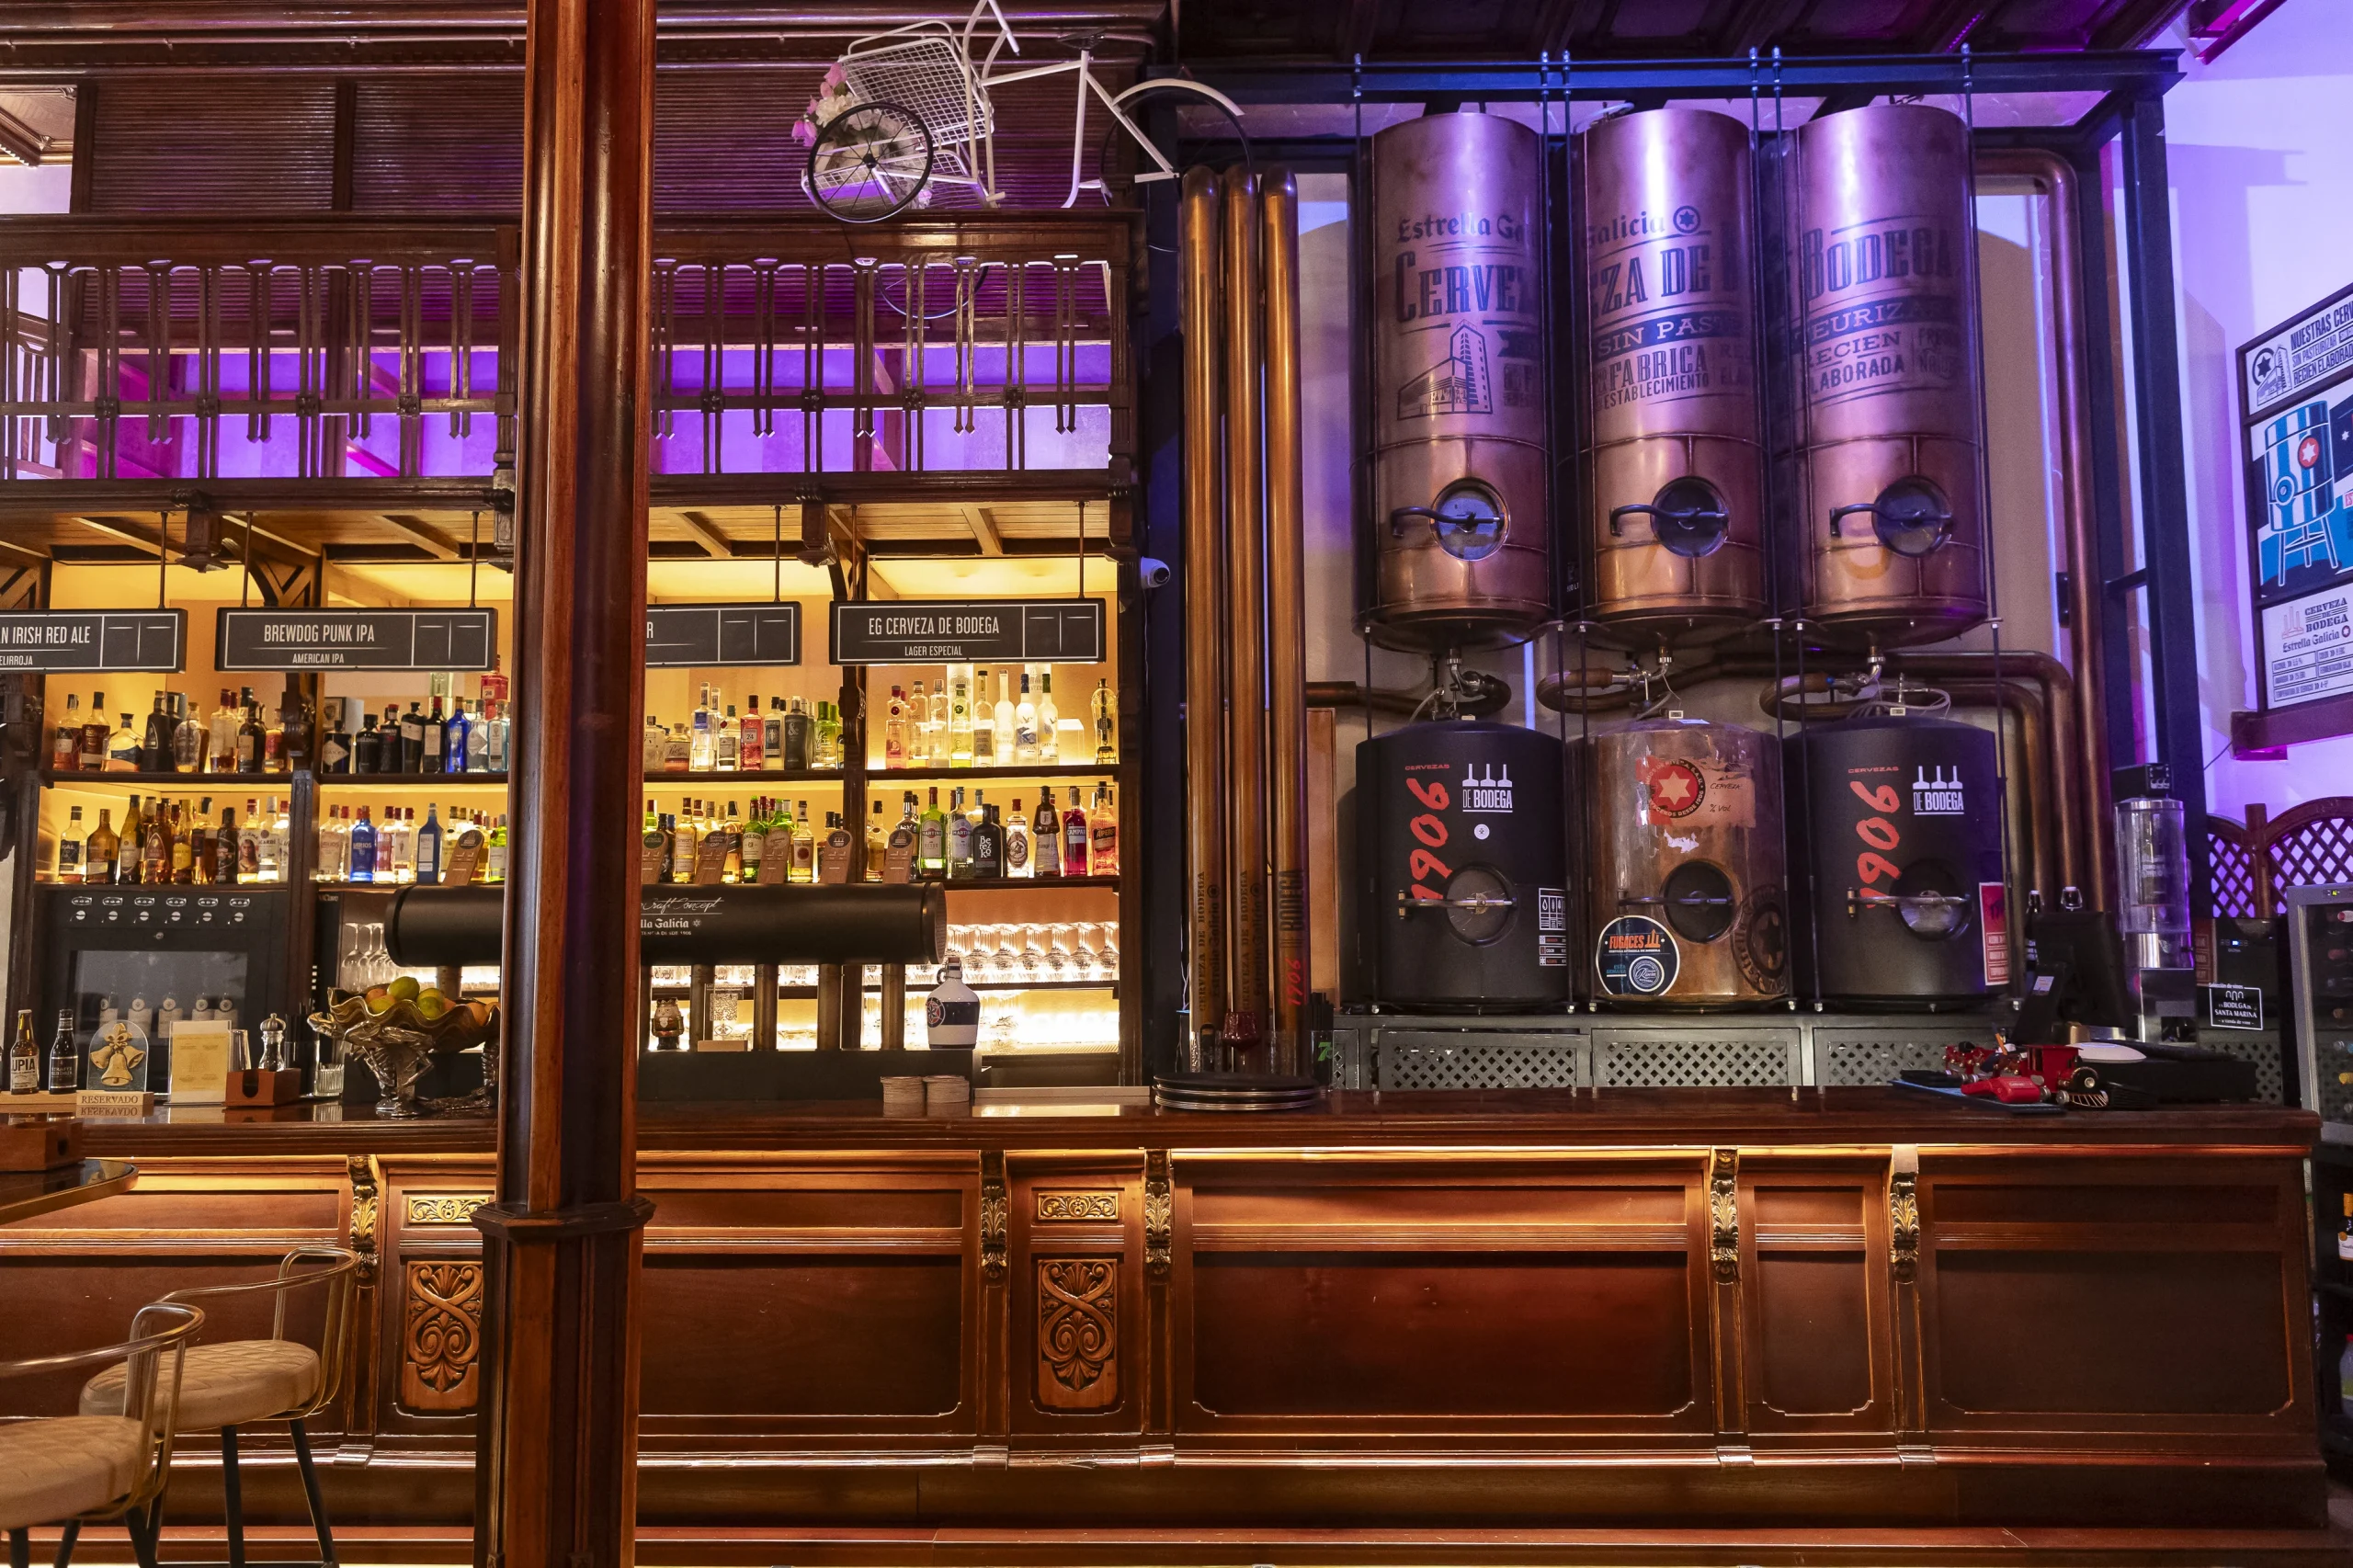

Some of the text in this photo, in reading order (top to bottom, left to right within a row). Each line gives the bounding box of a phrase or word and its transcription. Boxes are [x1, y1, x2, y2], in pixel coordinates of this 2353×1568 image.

[1396, 211, 1492, 244] Estrella
[1660, 244, 1711, 298] DE
[2290, 312, 2332, 351] NUESTRAS
[2334, 301, 2353, 328] CERV
[1597, 327, 1644, 356] SIN
[1609, 344, 1708, 392] FABRICA
[1809, 355, 1905, 394] LABORADA
[2293, 361, 2316, 386] RECIEN
[1604, 371, 1710, 410] ESTABLECIMIENTO
[2304, 597, 2348, 616] CERVEZA
[264, 624, 375, 642] BREWDOG PUNK IPA
[869, 617, 1000, 635] EG CERVEZA DE BODEGA
[2305, 614, 2349, 633] BODEGA
[13, 626, 42, 644] IRISH
[46, 626, 67, 643] RED
[71, 626, 91, 643] ALE
[2282, 630, 2340, 653] Estrella Galicia
[0, 655, 33, 666] ELIRROJA
[292, 653, 345, 664] AMERICAN IPA
[904, 645, 963, 656] LAGER ESPECIAL
[1847, 766, 1899, 774] CERVEZAS
[1462, 790, 1513, 809] DE BODEGA
[1677, 803, 1697, 816] DESDE
[1695, 790, 1704, 805] 1906
[1913, 791, 1963, 811] DE BODEGA
[1197, 871, 1205, 923] BODEGA
[1278, 869, 1304, 932] BODEGA
[655, 917, 689, 928] Galicia
[1608, 935, 1645, 949] FUGACES
[1286, 958, 1302, 1006] 1906
[81, 1095, 139, 1105] RESERVADO
